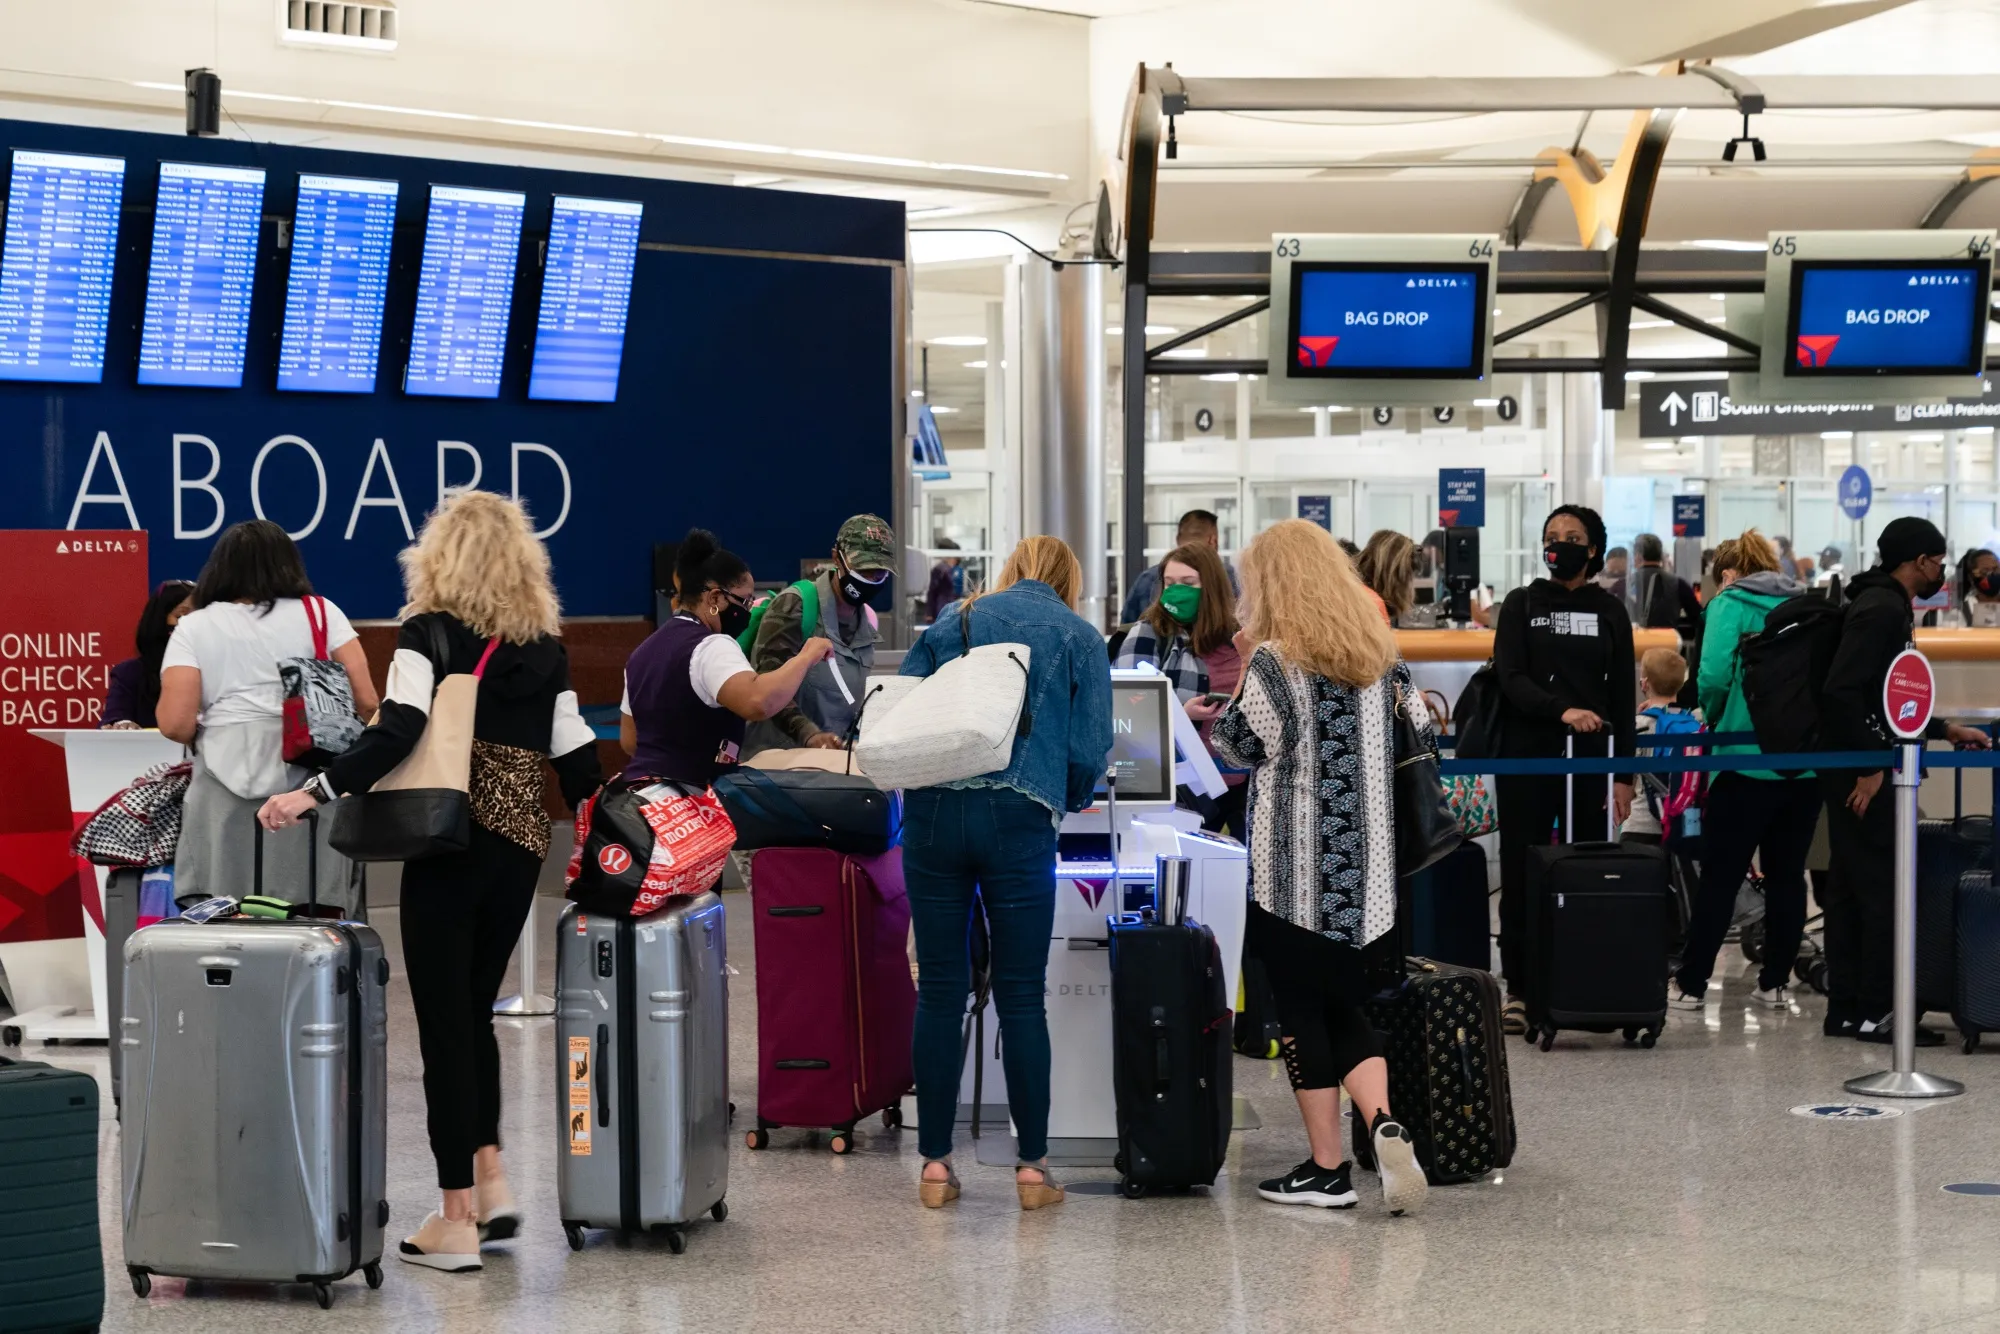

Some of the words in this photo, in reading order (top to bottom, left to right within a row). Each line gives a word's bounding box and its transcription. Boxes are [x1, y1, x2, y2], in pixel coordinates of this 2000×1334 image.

[1276, 238, 1301, 257] 63
[1468, 239, 1493, 258] 64
[1772, 236, 1797, 256] 65
[1967, 235, 1992, 254] 66
[1418, 279, 1458, 288] DELTA
[1920, 276, 1959, 285] DELTA
[1344, 311, 1379, 326] BAG
[1382, 311, 1429, 326] DROP
[1845, 309, 1880, 325] BAG
[1883, 309, 1930, 324] DROP
[1913, 404, 1954, 418] CLEAR
[66, 431, 571, 541] ABOARD
[73, 540, 124, 552] DELTA
[1, 632, 101, 659] ONLINE
[1, 664, 115, 692] CHECK-I
[2, 698, 58, 725] BAG
[66, 697, 106, 724] DR
[1059, 984, 1109, 996] DELT
